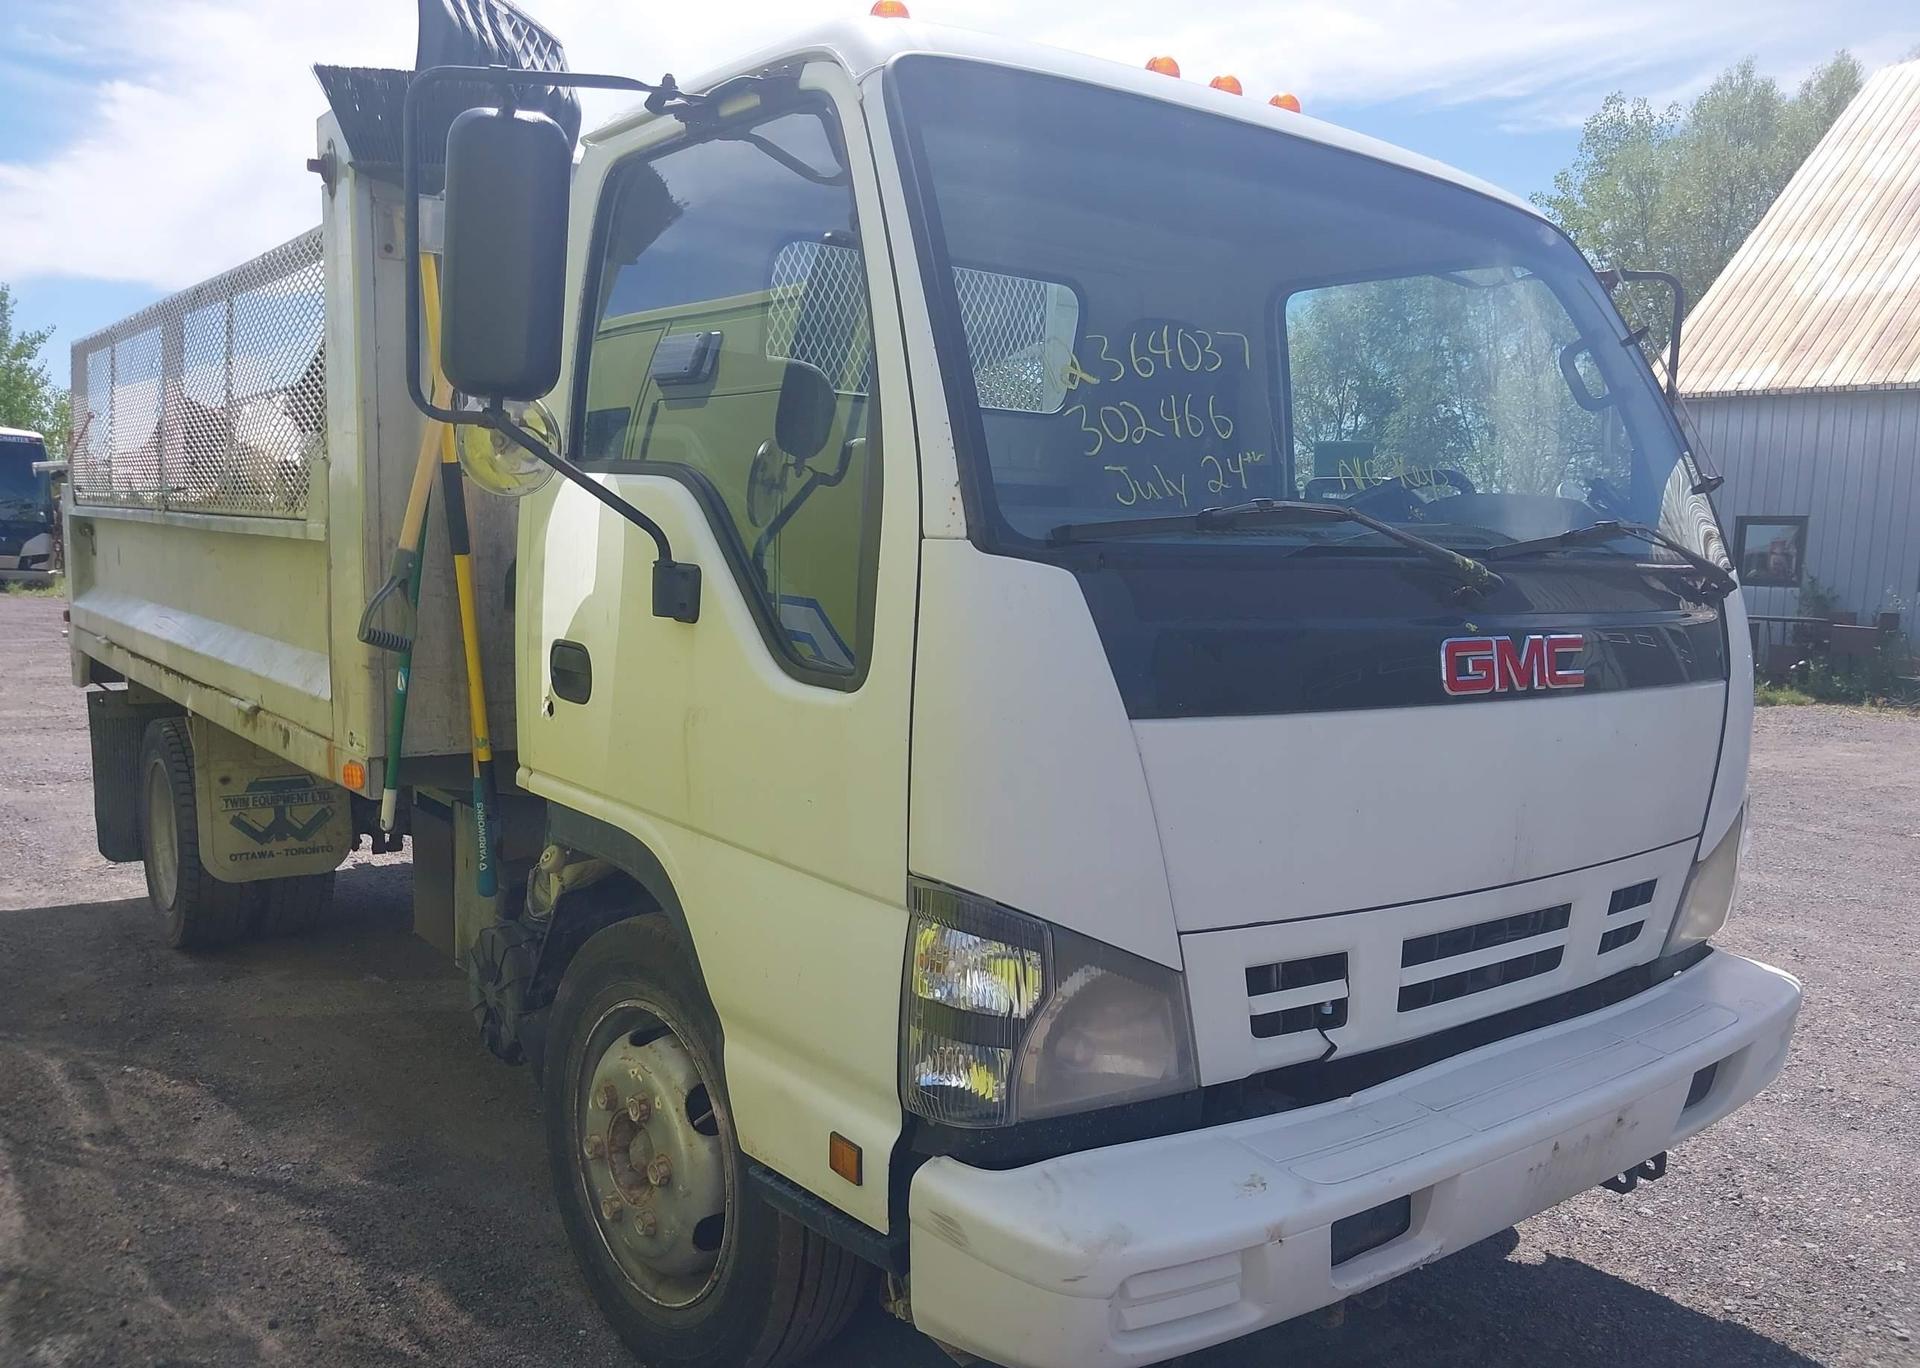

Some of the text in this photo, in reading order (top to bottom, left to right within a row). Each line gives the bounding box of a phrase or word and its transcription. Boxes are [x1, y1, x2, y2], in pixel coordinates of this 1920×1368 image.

[1063, 394, 1234, 456] 302466
[1104, 465, 1188, 507] July
[1441, 634, 1585, 696] GMC
[223, 797, 250, 809] TWIN
[251, 792, 309, 807] EQUIPMENT
[229, 850, 275, 862] OTTAWA
[284, 844, 334, 857] TORONTO
[476, 801, 488, 861] YARDWORKS
